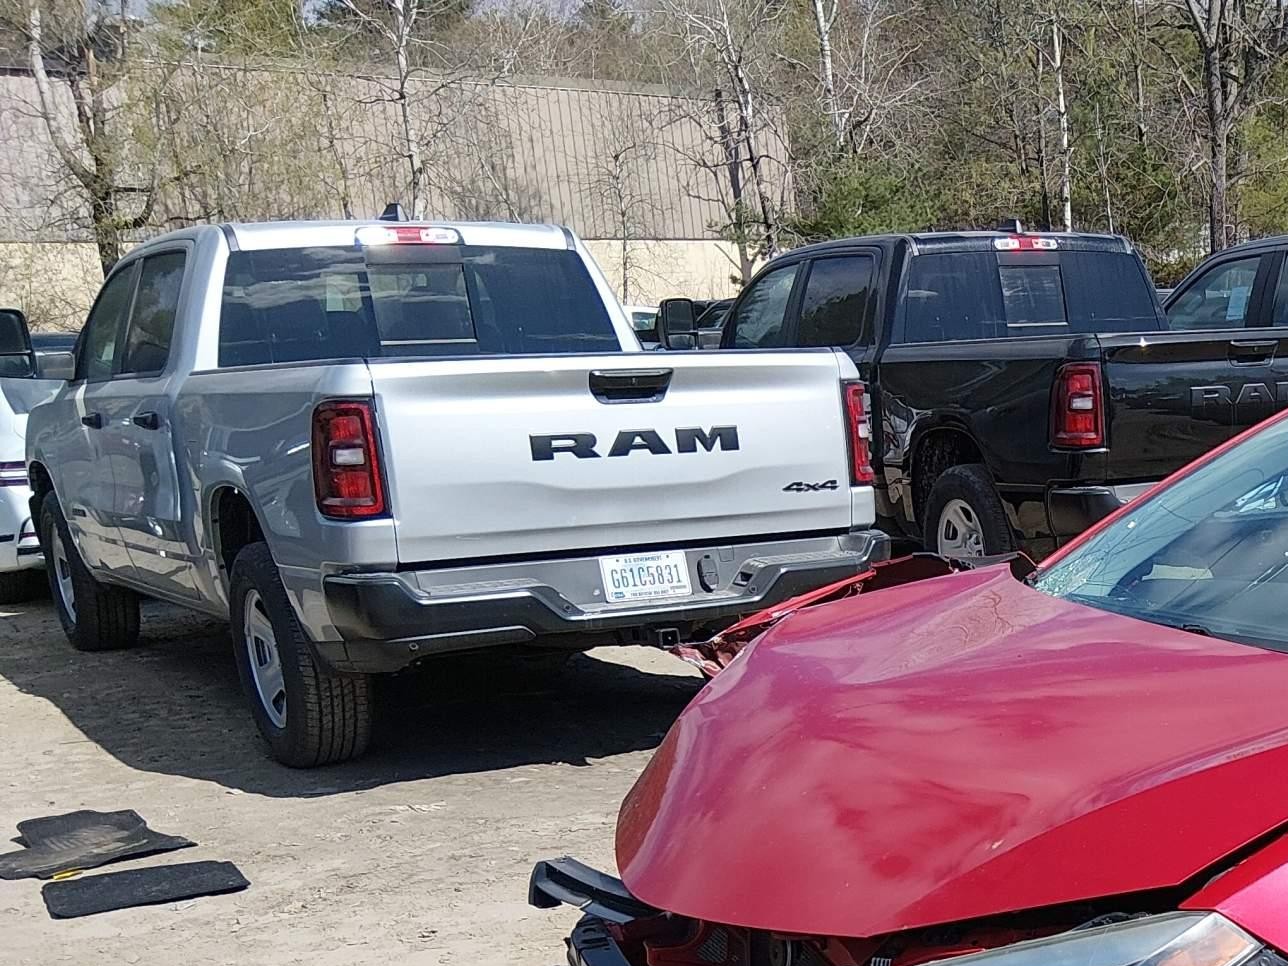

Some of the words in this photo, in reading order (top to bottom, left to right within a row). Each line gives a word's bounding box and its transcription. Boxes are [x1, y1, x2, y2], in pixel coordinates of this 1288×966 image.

[529, 425, 740, 461] RAM
[782, 479, 838, 493] 4x4
[611, 564, 682, 589] G61C5831
